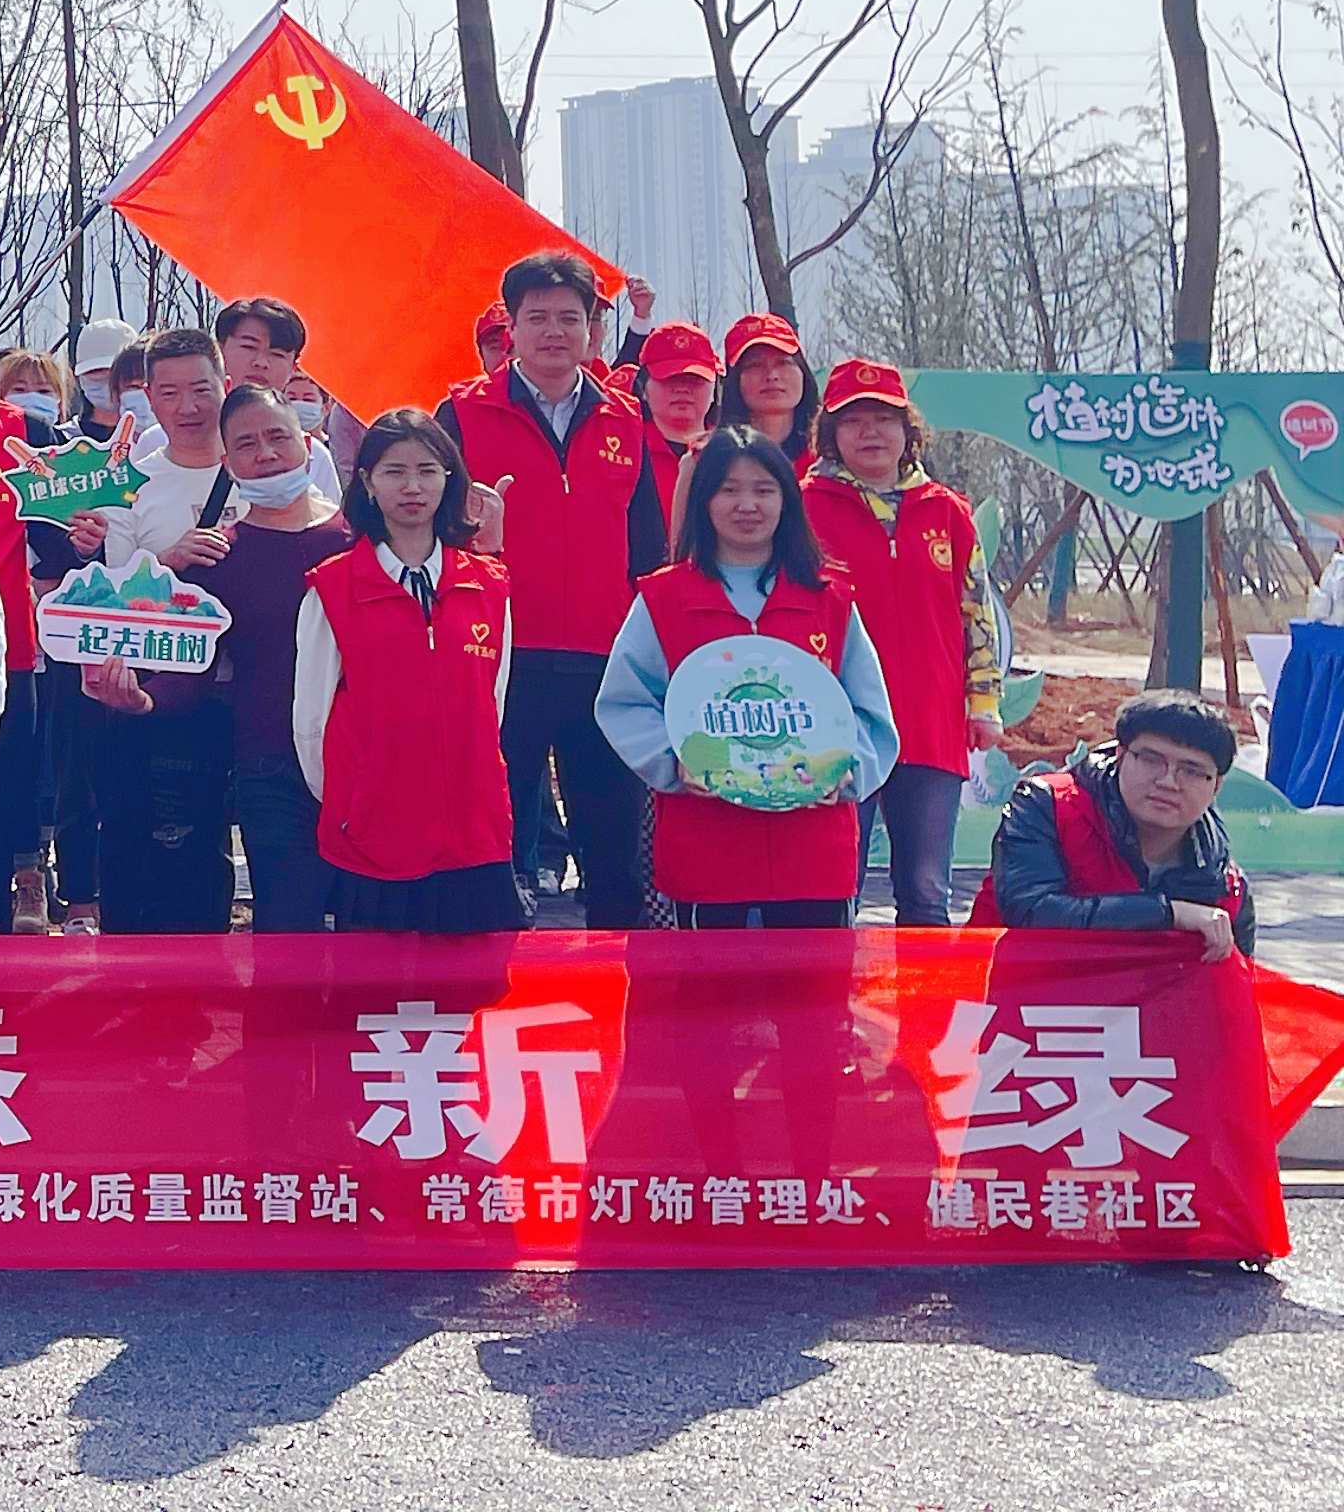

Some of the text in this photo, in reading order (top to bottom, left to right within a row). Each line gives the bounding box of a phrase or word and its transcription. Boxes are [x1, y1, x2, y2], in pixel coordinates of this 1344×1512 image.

[1026, 375, 1225, 441] 植树造林
[29, 465, 130, 501] 地球守护者
[1102, 442, 1232, 494] 为地球
[46, 624, 206, 664] 一起去植树
[703, 701, 812, 734] 植树节
